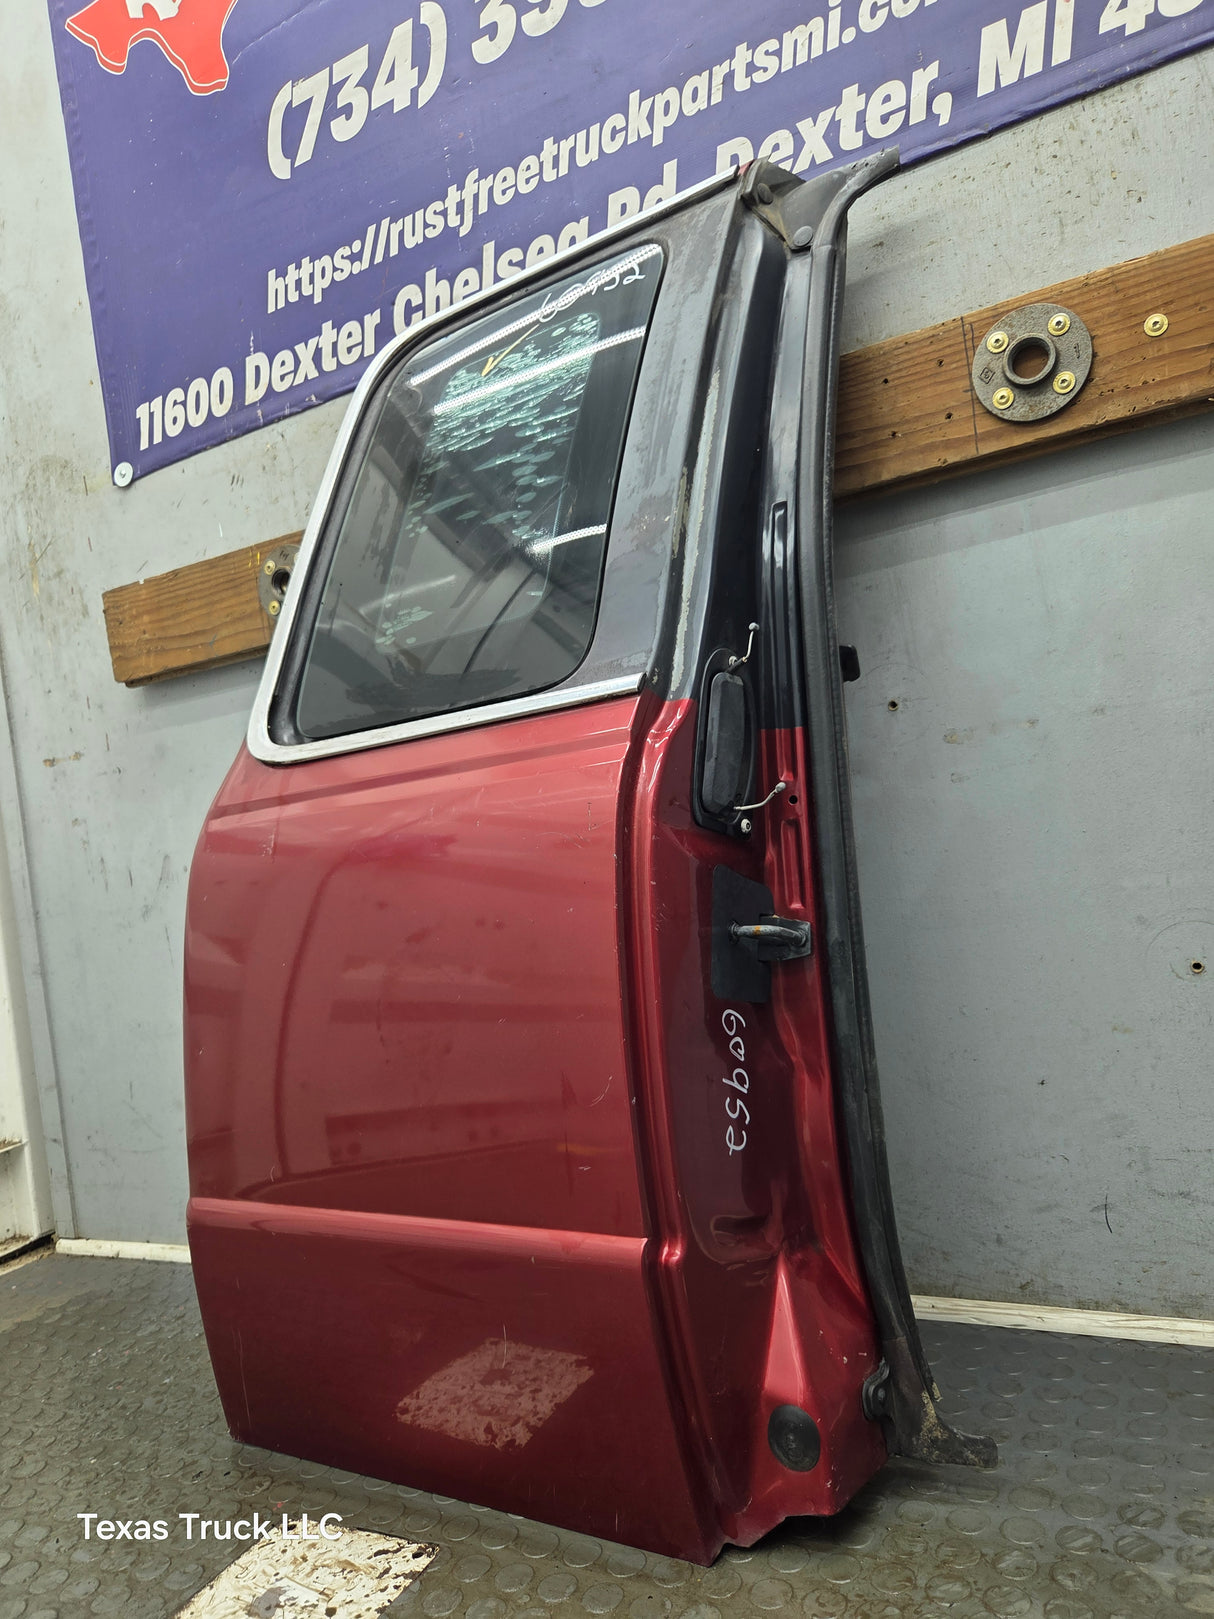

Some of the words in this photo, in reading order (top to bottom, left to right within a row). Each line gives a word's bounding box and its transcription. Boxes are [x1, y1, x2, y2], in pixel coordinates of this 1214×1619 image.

[267, 1, 447, 180] (734)
[268, 0, 938, 313] https://rustfreetruckpartsmi.c
[136, 367, 233, 451] 11600
[245, 309, 380, 406] Dexter
[977, 0, 1075, 97] MI
[722, 1009, 750, 1156] 60952
